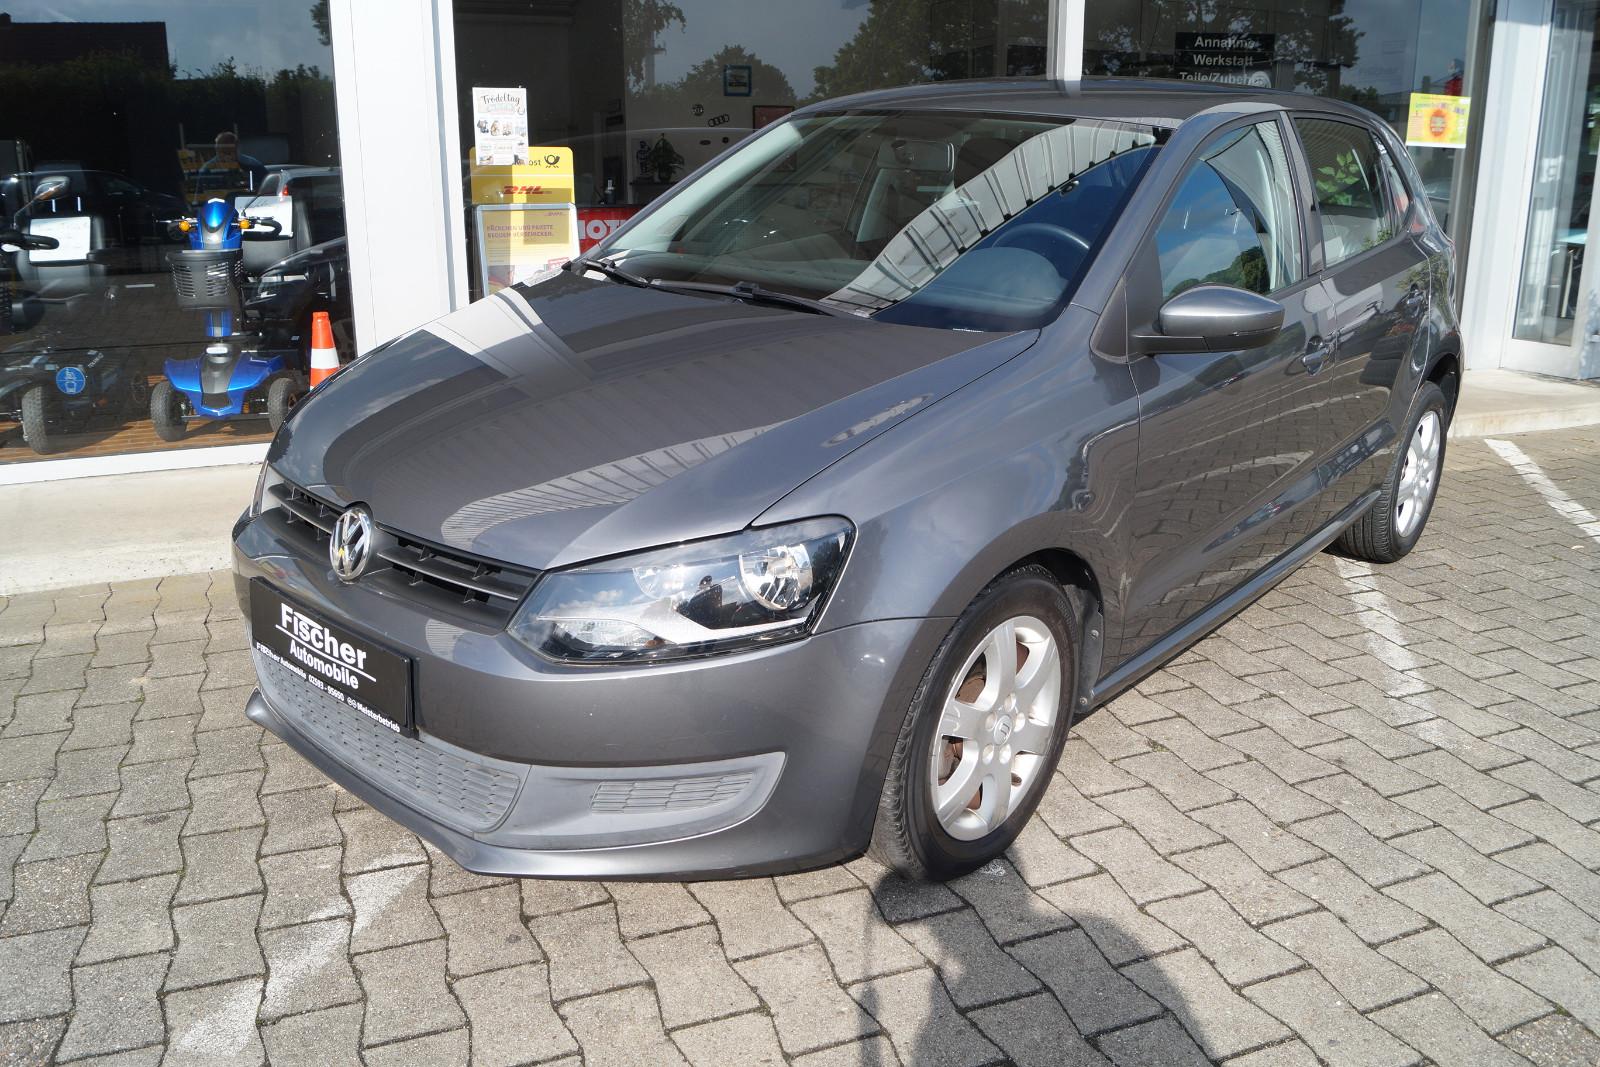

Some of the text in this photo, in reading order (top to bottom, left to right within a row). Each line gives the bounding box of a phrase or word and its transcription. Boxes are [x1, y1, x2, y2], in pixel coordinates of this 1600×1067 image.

[1193, 54, 1253, 66] Werkstatt
[481, 93, 520, 106] Trödeltag
[503, 186, 544, 195] DHL
[280, 602, 367, 670] Fischer
[290, 640, 359, 689] Automobile
[356, 702, 401, 733] Meisterbetrieb
